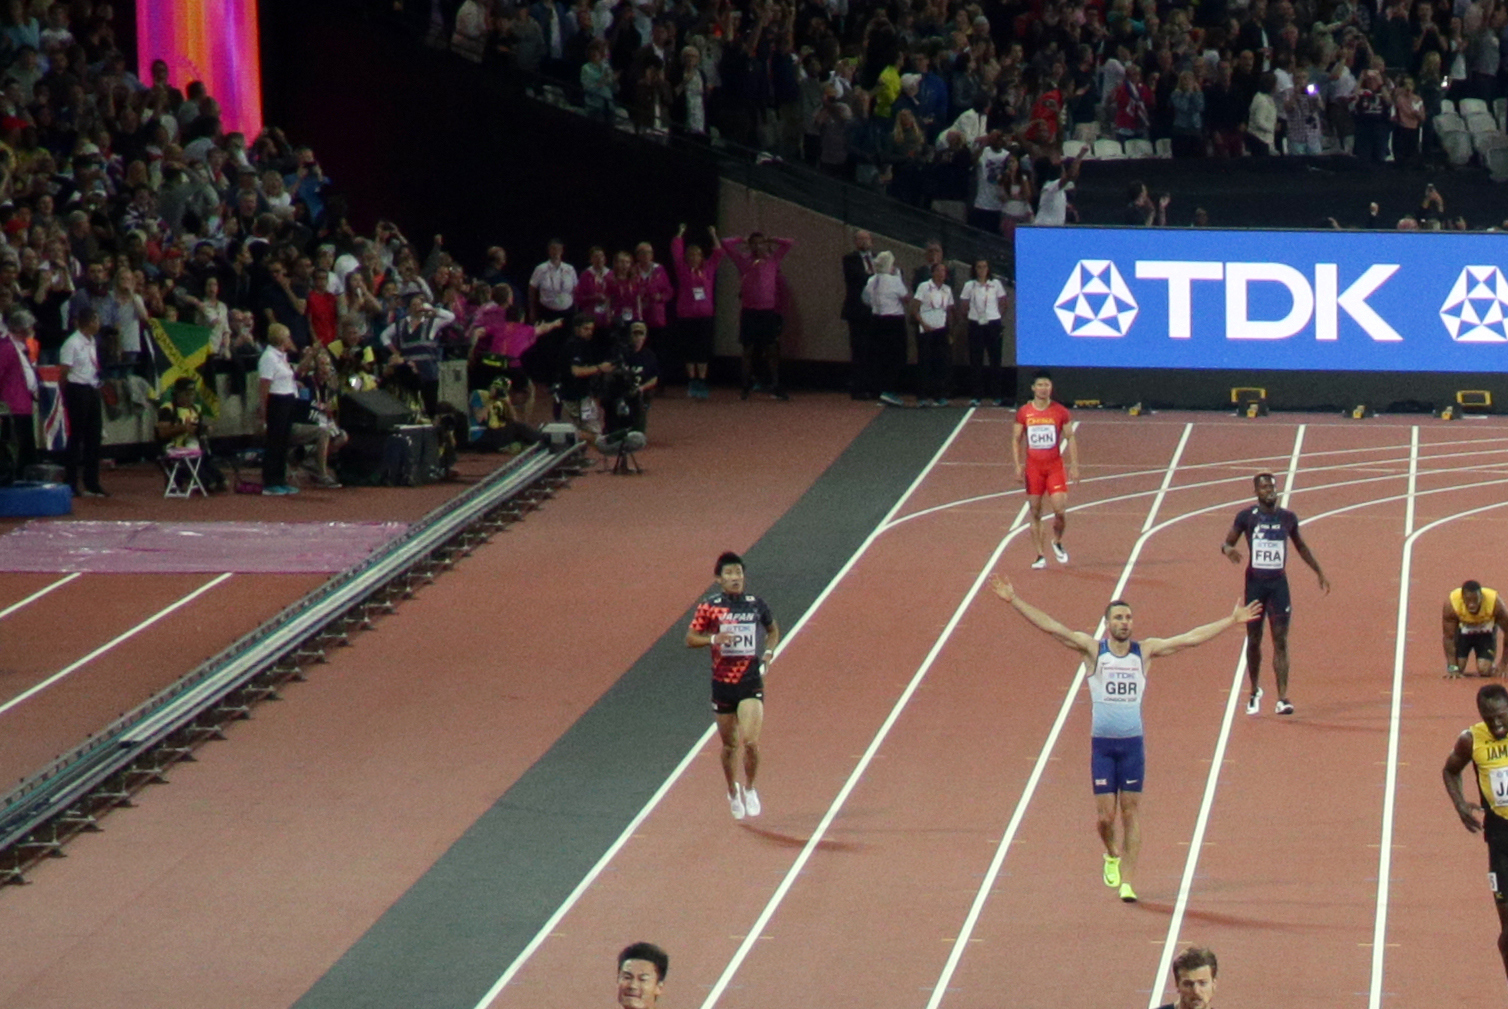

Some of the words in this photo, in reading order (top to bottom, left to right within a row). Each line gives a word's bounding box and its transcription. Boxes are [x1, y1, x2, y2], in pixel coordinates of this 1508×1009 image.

[1135, 260, 1404, 341] TDK
[1030, 433, 1054, 443] CHN
[1255, 550, 1281, 562] FRA
[720, 612, 755, 621] JAPAN
[1106, 681, 1137, 695] GBR
